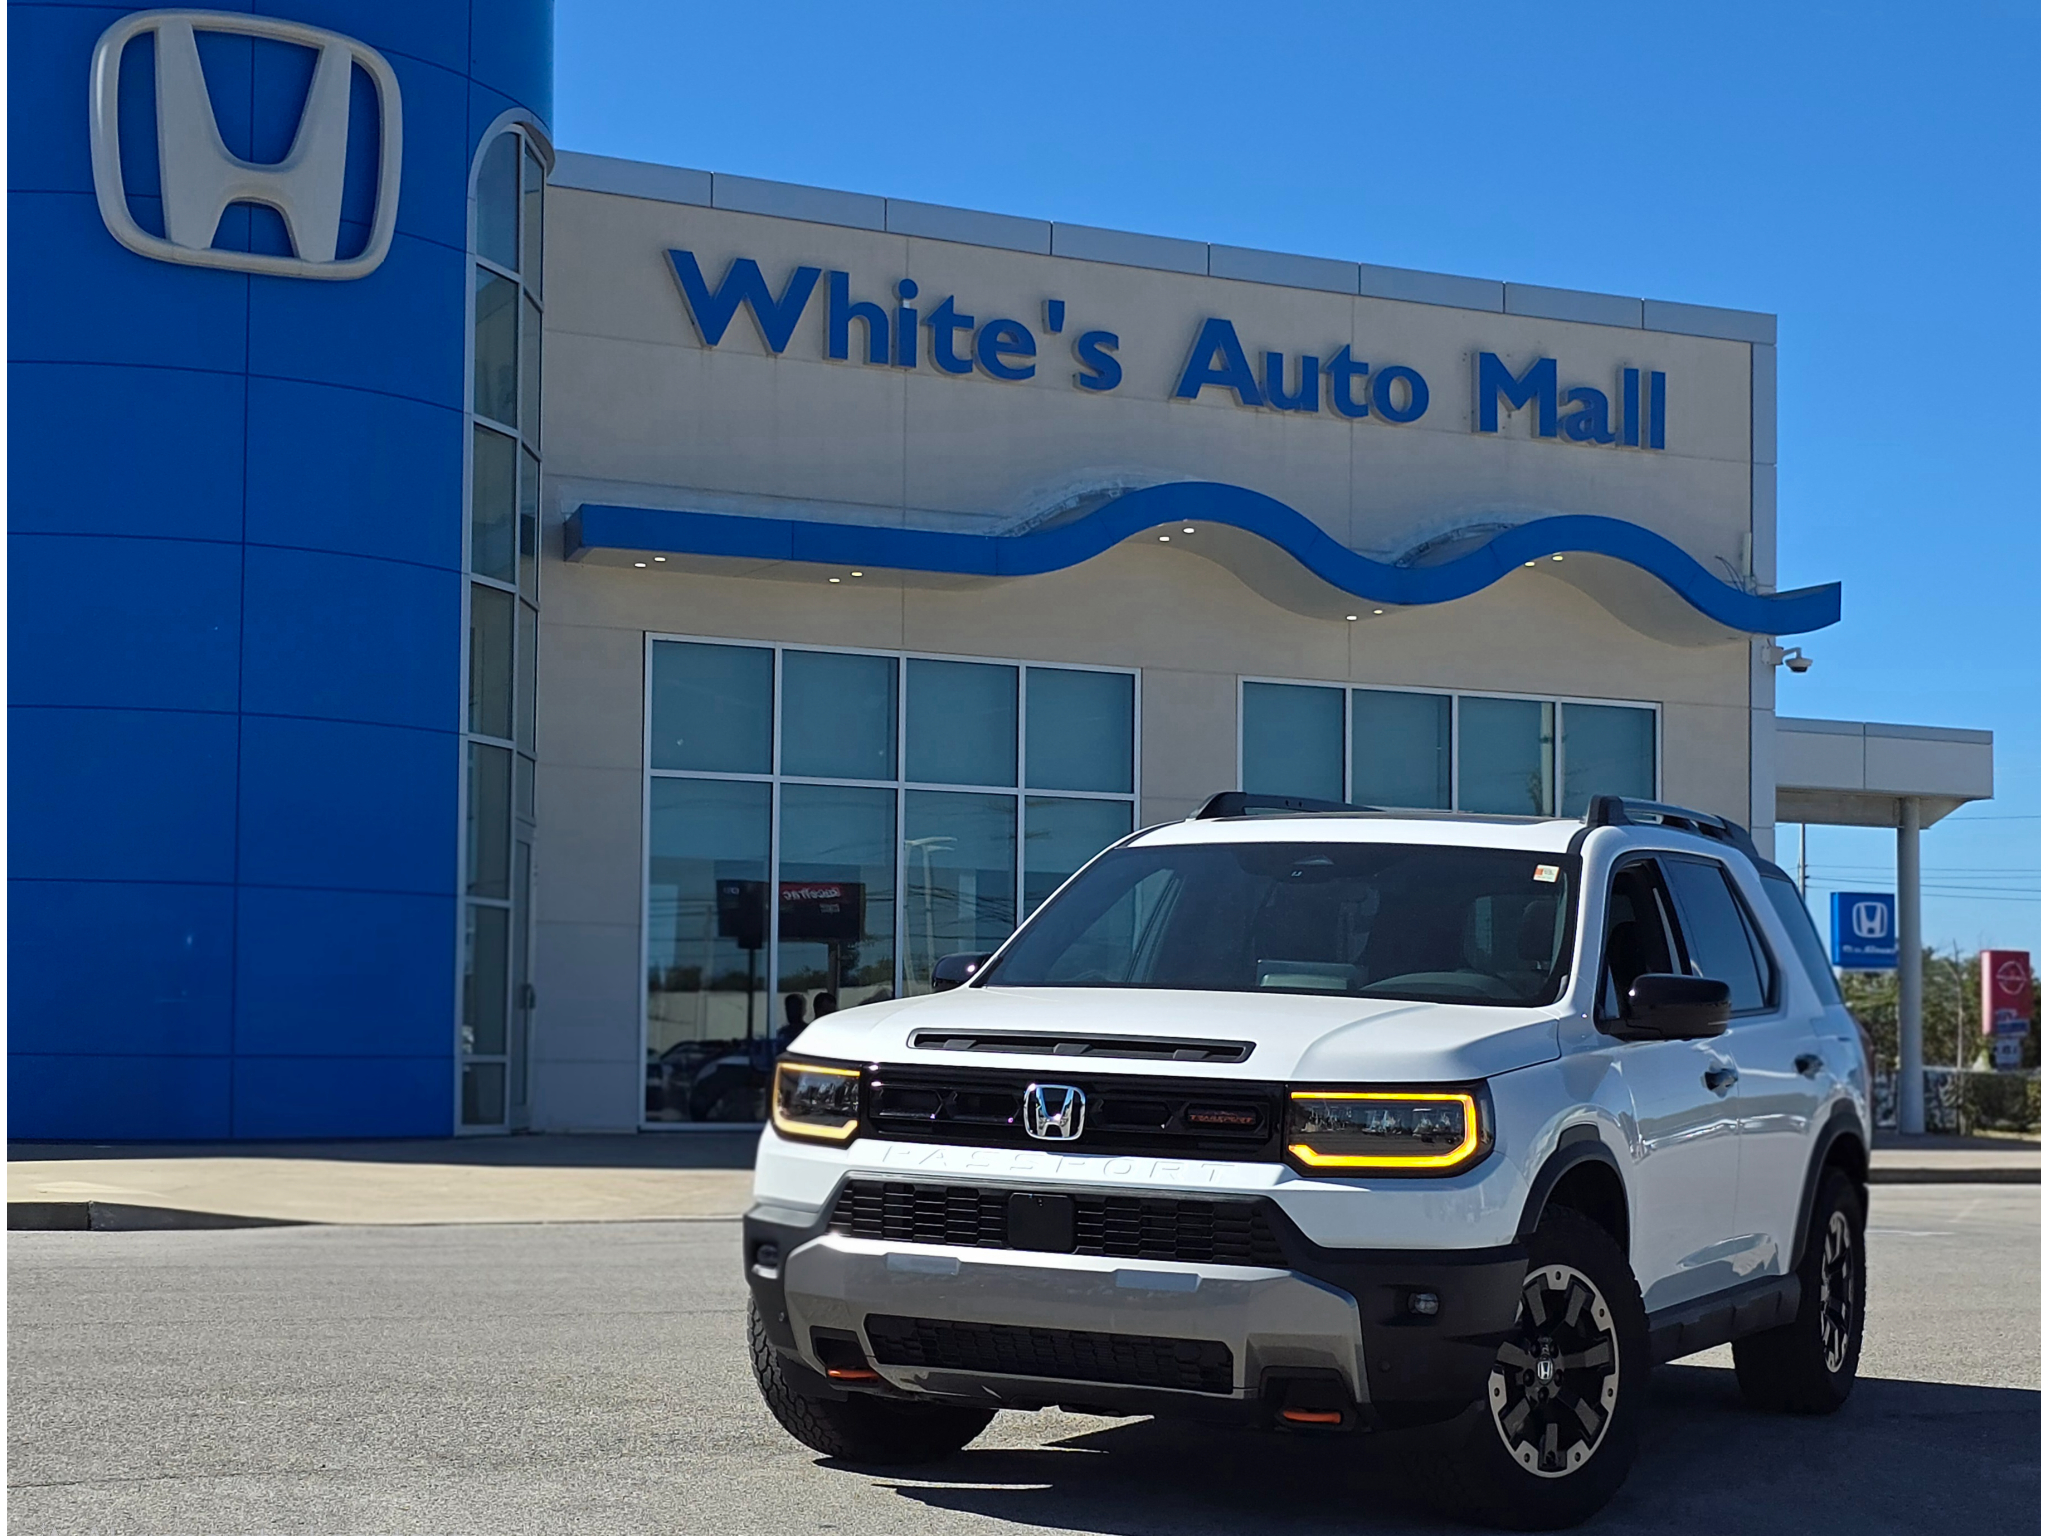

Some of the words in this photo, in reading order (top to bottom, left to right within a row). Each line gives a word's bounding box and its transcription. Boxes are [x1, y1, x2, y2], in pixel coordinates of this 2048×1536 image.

[664, 248, 1123, 392] White's
[1169, 317, 1430, 424] Auto
[1472, 351, 1667, 450] Mall
[881, 1144, 1237, 1183] PASSPORT
